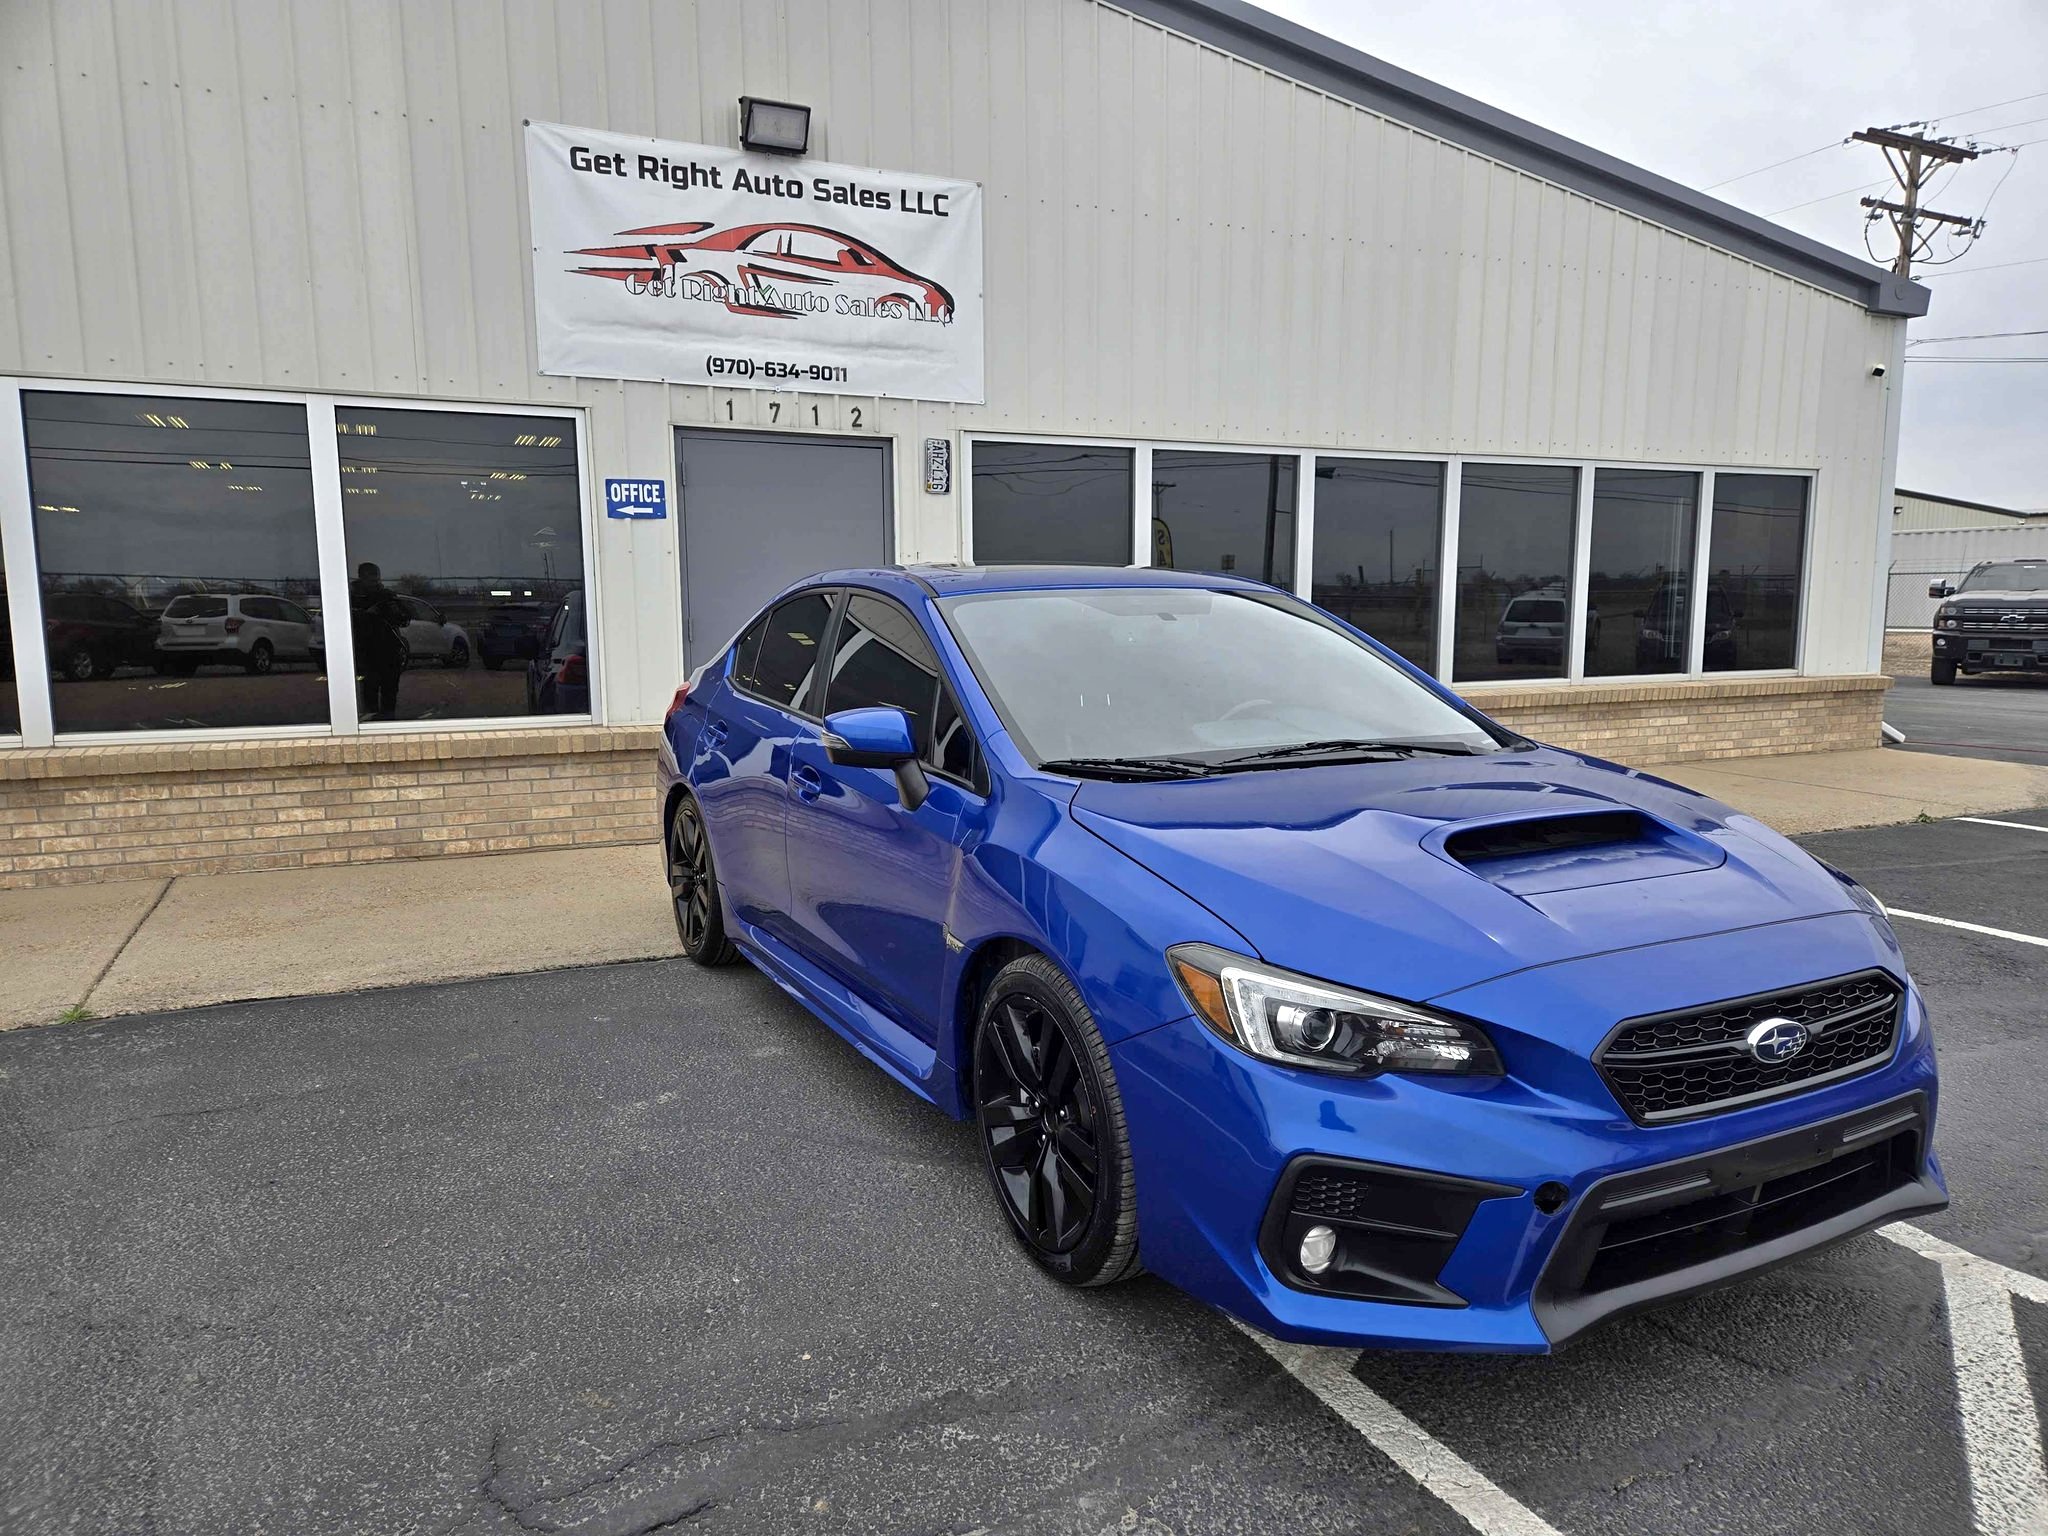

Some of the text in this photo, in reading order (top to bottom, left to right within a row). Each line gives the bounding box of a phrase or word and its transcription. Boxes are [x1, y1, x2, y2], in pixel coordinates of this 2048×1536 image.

[570, 146, 949, 217] Get Right Auto Sales LLC
[625, 273, 676, 298] Get
[682, 278, 757, 305] Right
[763, 287, 830, 313] Auto
[835, 293, 903, 319] Sales
[706, 355, 848, 383] (970)-634-9011
[610, 483, 661, 503] OFFICE
